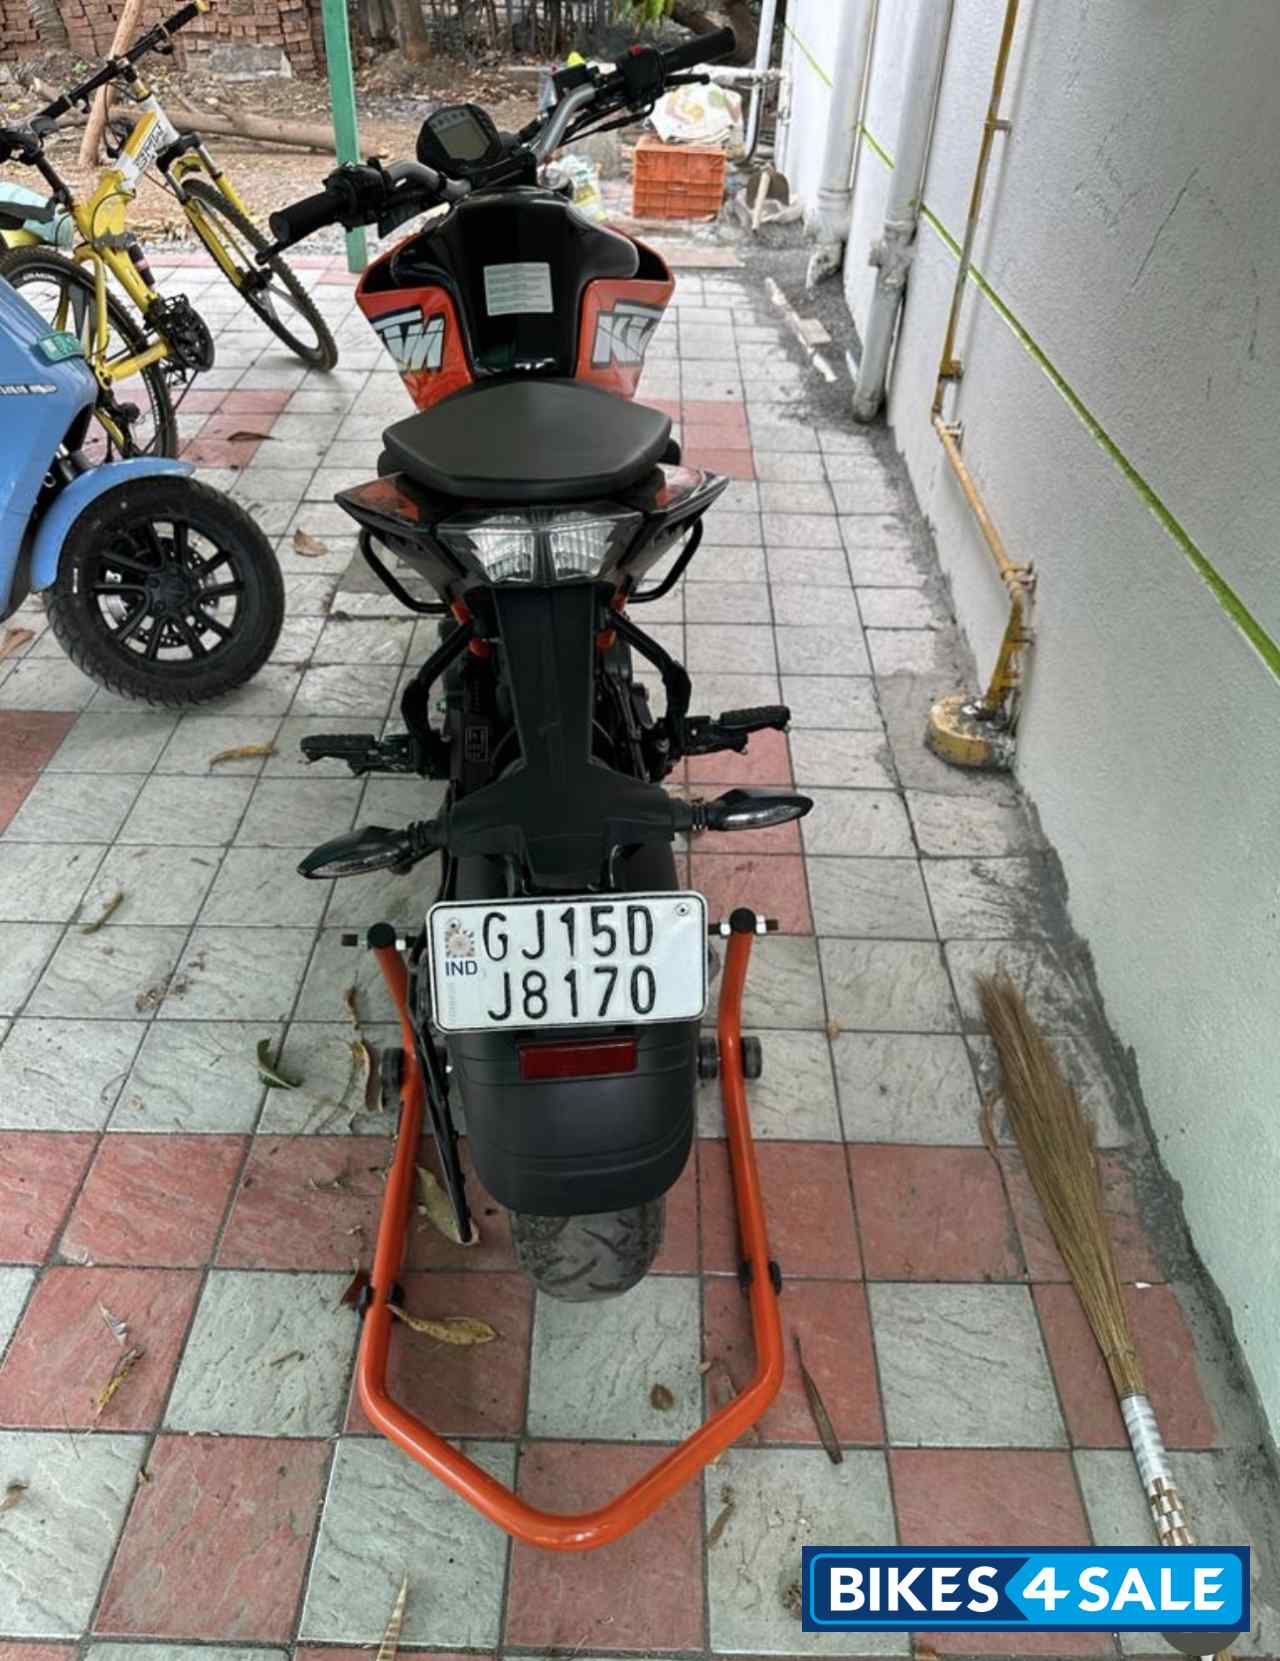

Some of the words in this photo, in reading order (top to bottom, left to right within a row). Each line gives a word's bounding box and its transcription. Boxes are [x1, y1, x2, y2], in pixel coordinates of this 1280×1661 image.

[369, 305, 446, 371] TM
[591, 299, 665, 369] KT
[482, 905, 654, 962] GJ15D
[445, 960, 478, 976] IND
[487, 964, 656, 1021] J8170
